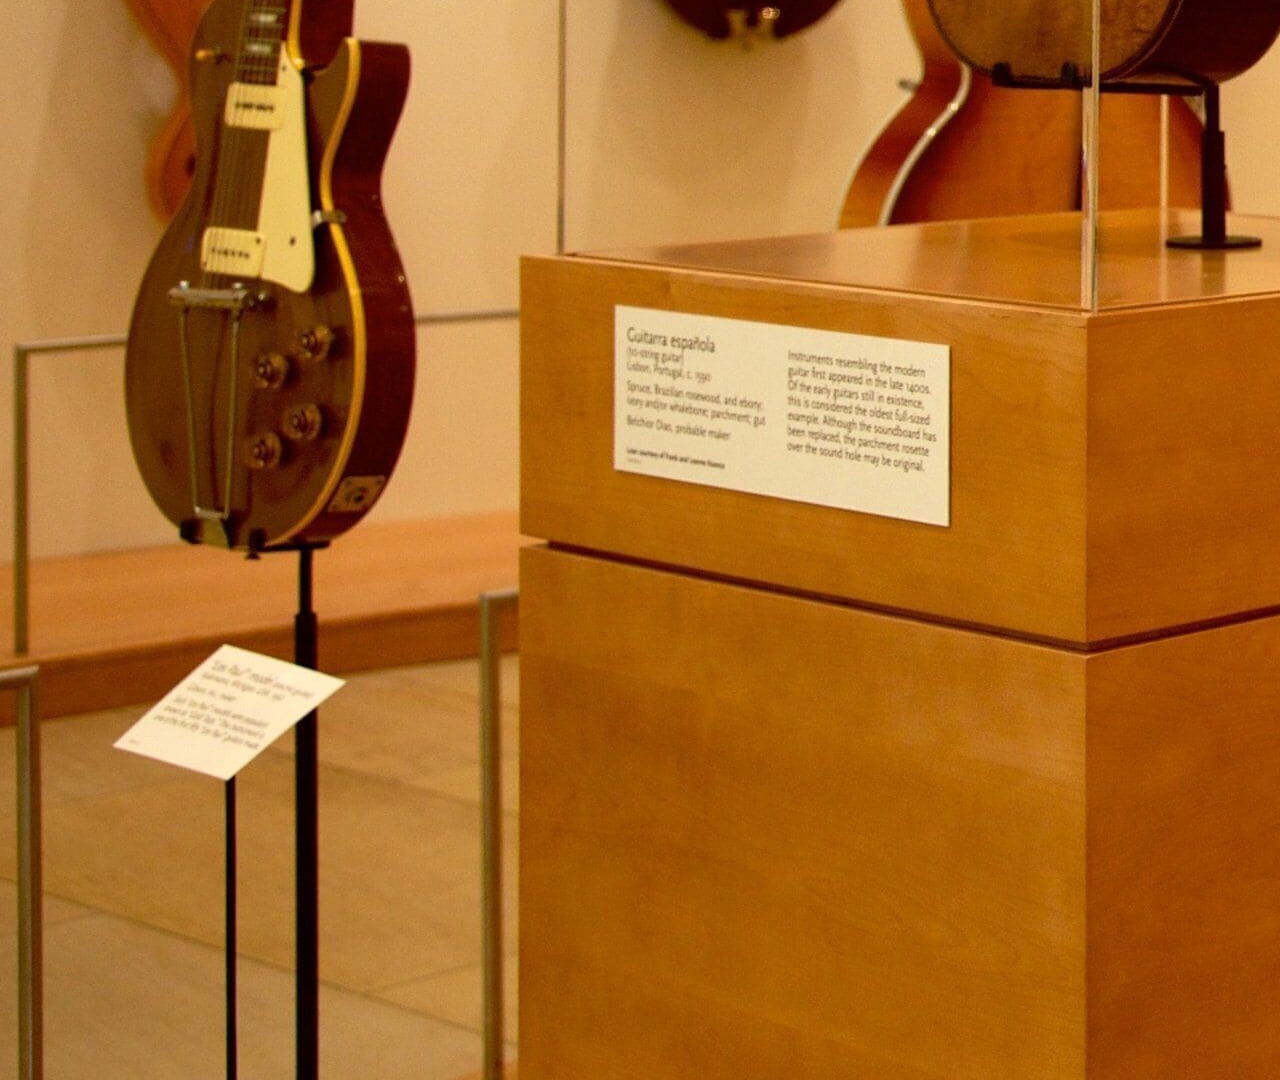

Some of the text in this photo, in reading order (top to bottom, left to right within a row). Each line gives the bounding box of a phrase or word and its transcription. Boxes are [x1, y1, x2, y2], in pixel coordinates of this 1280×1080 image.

[626, 326, 715, 354] Guitarra española
[788, 349, 926, 378] Instruments resembling the modern
[788, 366, 809, 380] guitar
[812, 366, 826, 380] first
[829, 372, 864, 387] appeared
[866, 377, 873, 386] in
[875, 376, 888, 388] the
[890, 378, 903, 391] late
[788, 380, 798, 391] Of
[800, 382, 812, 393] the
[814, 385, 830, 398] early
[834, 388, 860, 403] guitars
[861, 389, 874, 402] still
[878, 394, 884, 404] in
[788, 395, 930, 426] this is considered the oldest full-sized
[788, 424, 806, 438] been
[843, 432, 856, 446] the
[858, 436, 900, 454] parchment
[902, 443, 930, 457] rosette
[822, 415, 858, 434] Although
[860, 421, 872, 433] the
[874, 422, 920, 440] soundboard
[922, 429, 938, 442] has
[788, 443, 804, 453] over
[806, 443, 818, 455] the
[820, 445, 844, 459] sound
[845, 449, 862, 462] hole
[863, 455, 880, 467] may
[882, 454, 892, 467] be
